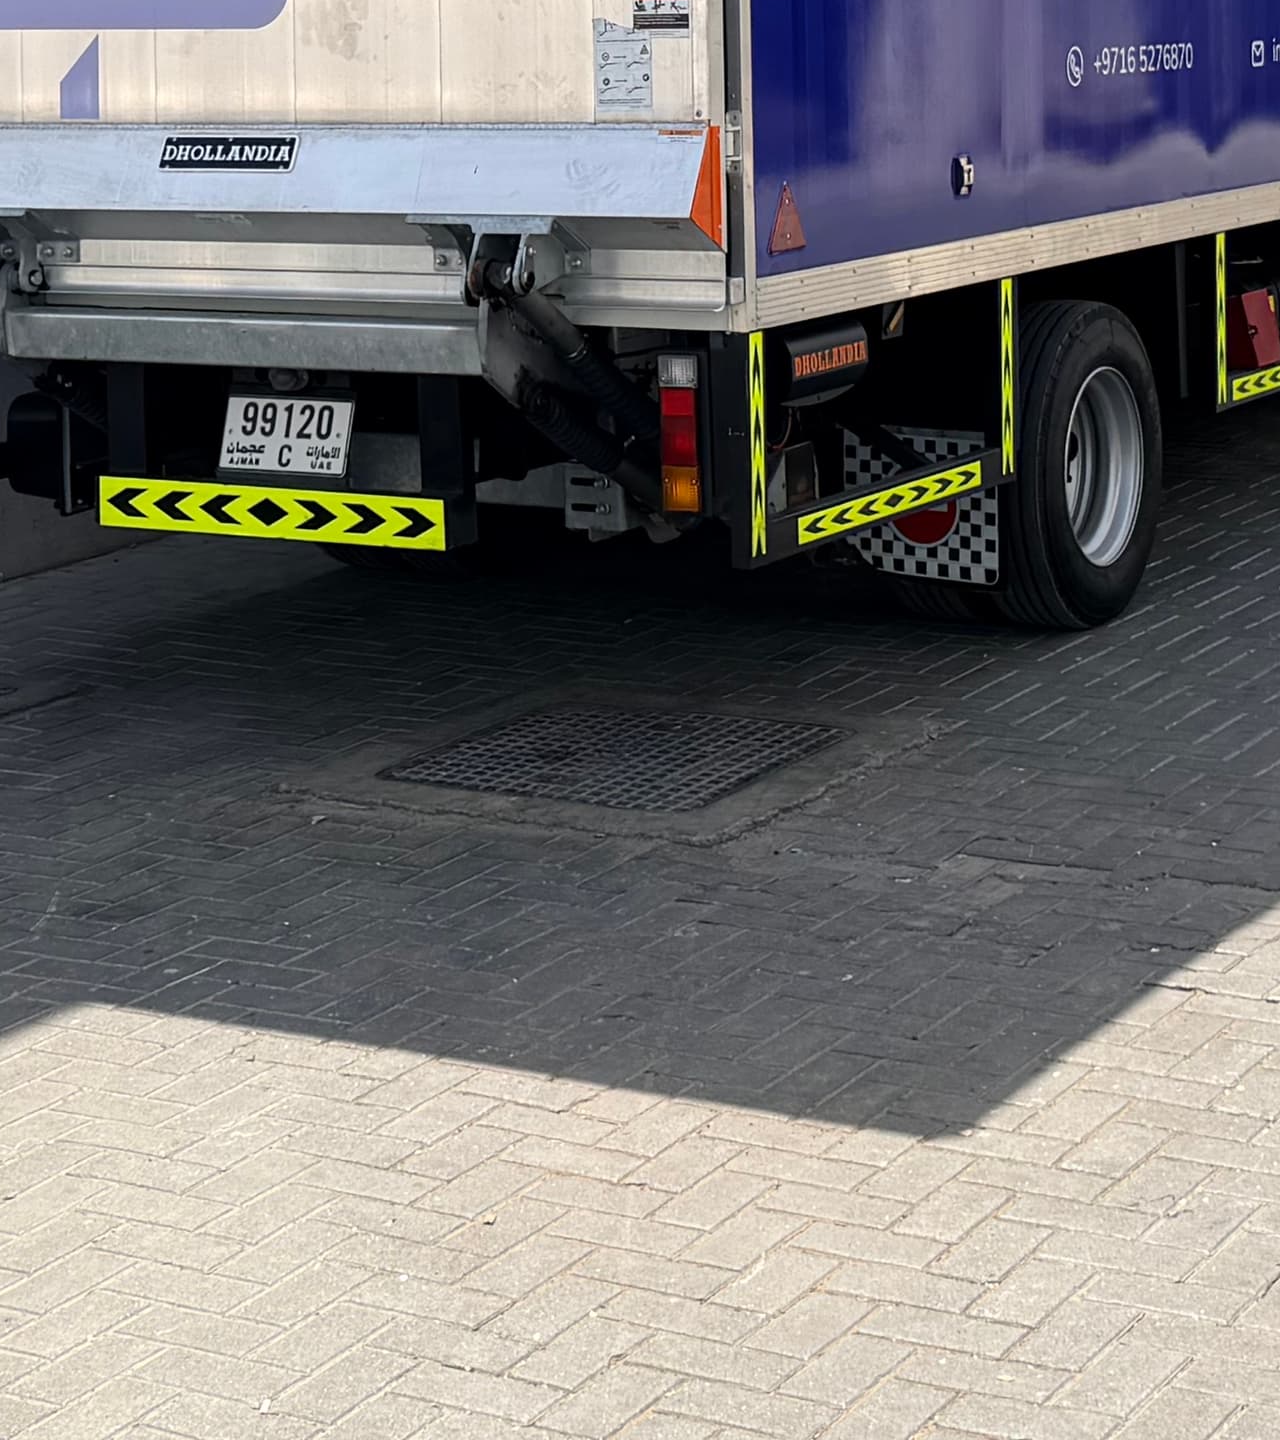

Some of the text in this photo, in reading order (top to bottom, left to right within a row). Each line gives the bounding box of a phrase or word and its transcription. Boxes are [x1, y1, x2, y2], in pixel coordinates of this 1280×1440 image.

[1139, 42, 1193, 73] 5276870
[163, 145, 290, 161] DHOLLANDIA
[794, 341, 866, 378] DHOLLANDIA
[241, 401, 335, 440] 99120
[226, 441, 266, 455] عجمان
[277, 444, 292, 467] C
[310, 461, 332, 470] UAE
